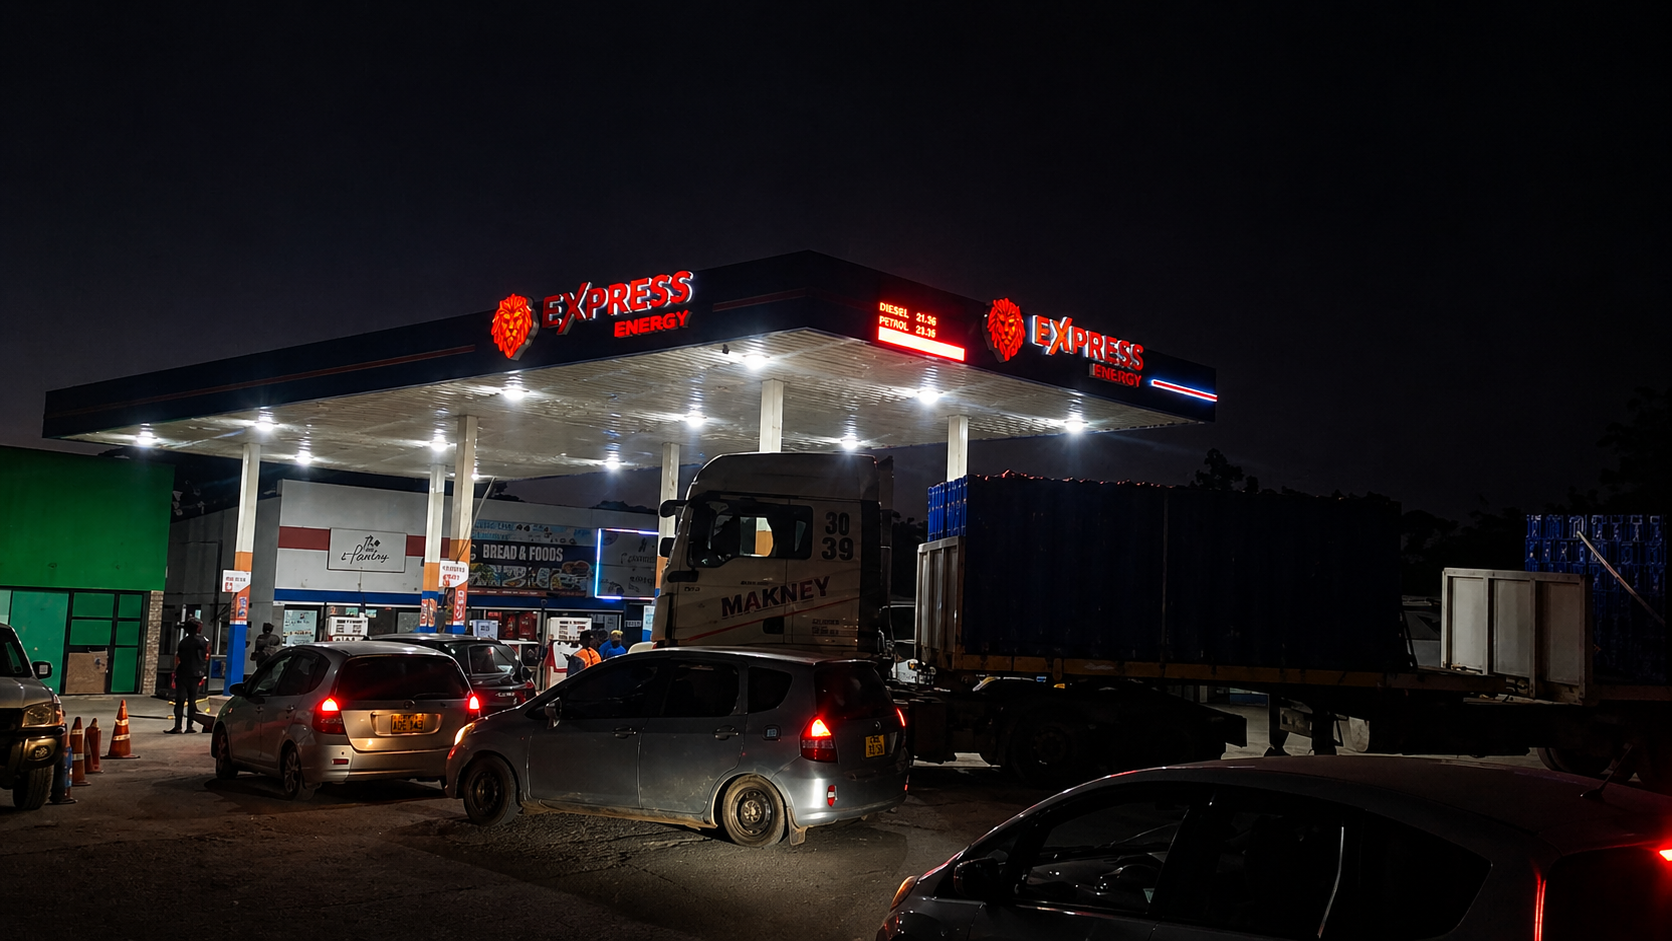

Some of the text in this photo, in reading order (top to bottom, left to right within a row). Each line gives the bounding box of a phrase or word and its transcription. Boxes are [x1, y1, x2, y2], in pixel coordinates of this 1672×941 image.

[542, 271, 694, 335] EXPRESS
[879, 302, 909, 319] DIESEL
[614, 310, 690, 338] ENERGY
[1032, 315, 1144, 371] EXPRESS
[1092, 363, 1142, 388] ENERGY
[825, 511, 850, 536] 30
[482, 544, 518, 561] BREAD
[518, 546, 527, 561] &
[529, 546, 564, 562] FOODS
[821, 536, 854, 561] 39
[721, 576, 831, 617] MAKNEY
